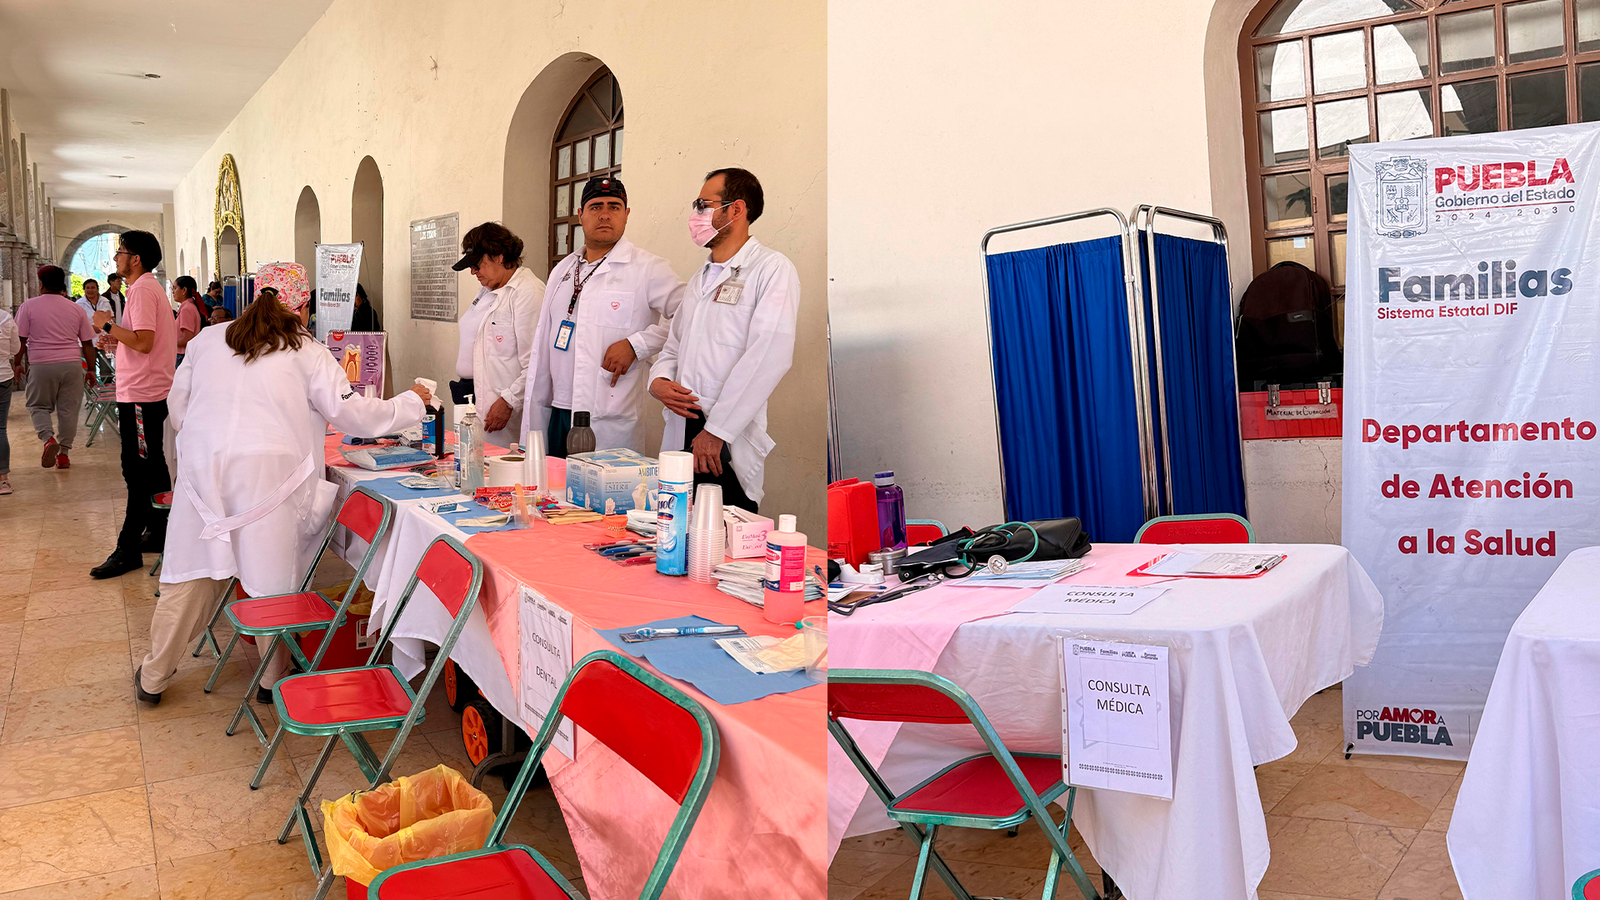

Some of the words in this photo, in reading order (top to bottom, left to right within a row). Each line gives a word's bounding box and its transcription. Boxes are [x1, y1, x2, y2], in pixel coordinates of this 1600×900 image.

[1435, 158, 1575, 194] PUEBLA
[1435, 193, 1499, 208] Gobierno
[1501, 190, 1523, 204] del
[1526, 187, 1575, 201] Estado
[1378, 259, 1573, 303] Familias
[320, 288, 350, 303] Familias
[1377, 306, 1434, 320] Sistema
[1438, 303, 1489, 317] Estatal
[1494, 302, 1518, 315] DIF
[1361, 416, 1597, 450] Departamento
[1381, 473, 1420, 499] de
[1428, 472, 1573, 499] Atención
[489, 495, 512, 503] Colgate
[757, 530, 768, 541] 3
[1398, 534, 1418, 554] a
[1427, 528, 1455, 554] la
[1463, 529, 1556, 557] Salud
[532, 632, 561, 660] CONSULTA
[536, 665, 557, 689] DENTAL
[1087, 679, 1151, 697] CONSULTA
[1097, 697, 1144, 715] MÉDICA
[1356, 709, 1380, 720] POR
[1380, 706, 1437, 725] AMOR
[1437, 715, 1446, 725] A
[1357, 720, 1454, 747] PUEBLA
